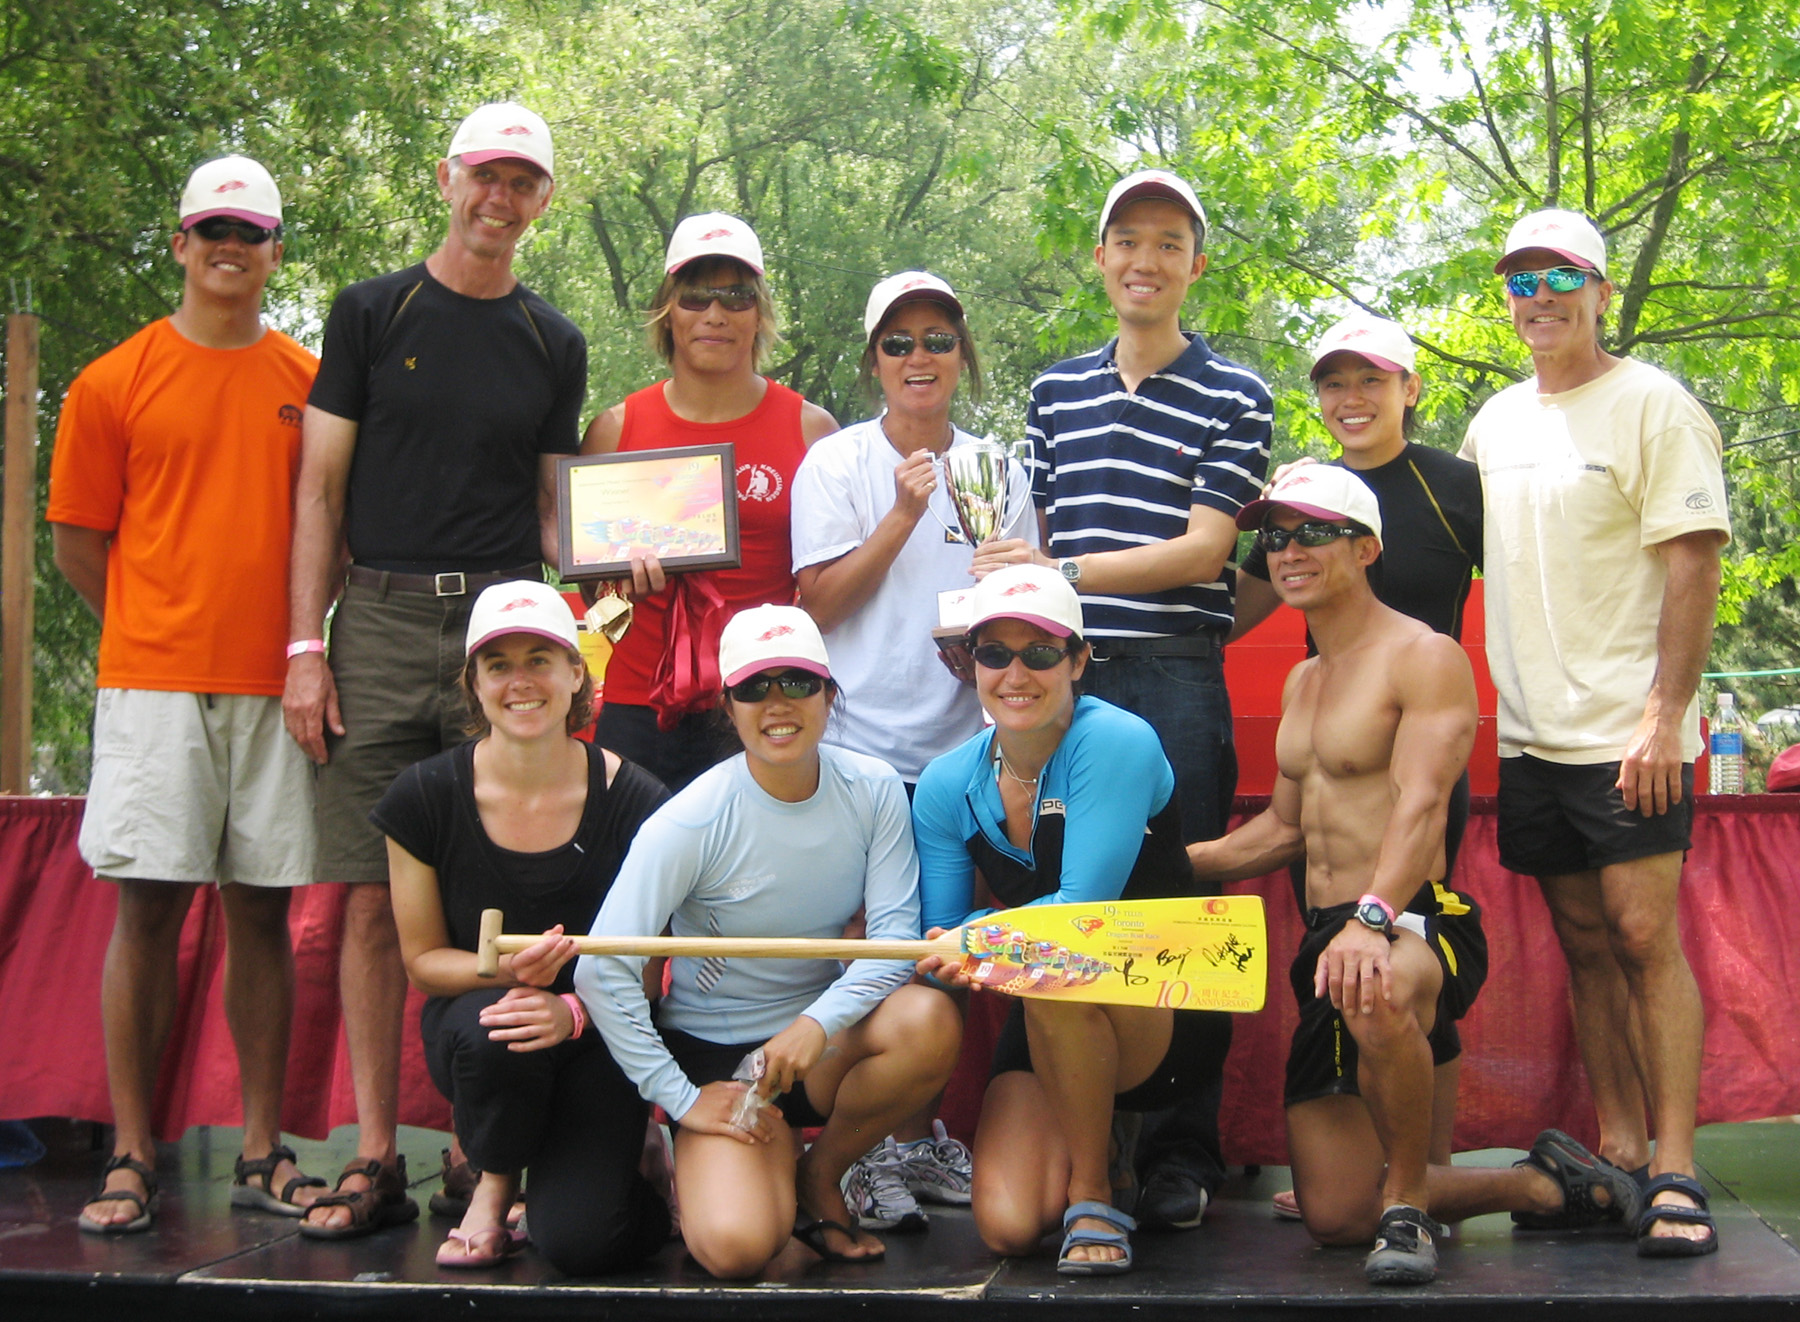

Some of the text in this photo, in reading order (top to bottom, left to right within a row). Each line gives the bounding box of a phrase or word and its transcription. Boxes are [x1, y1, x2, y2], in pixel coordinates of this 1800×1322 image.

[1113, 919, 1145, 928] Toronto
[1154, 980, 1189, 1009] 10
[1194, 997, 1251, 1009] ANNIVERSARY
